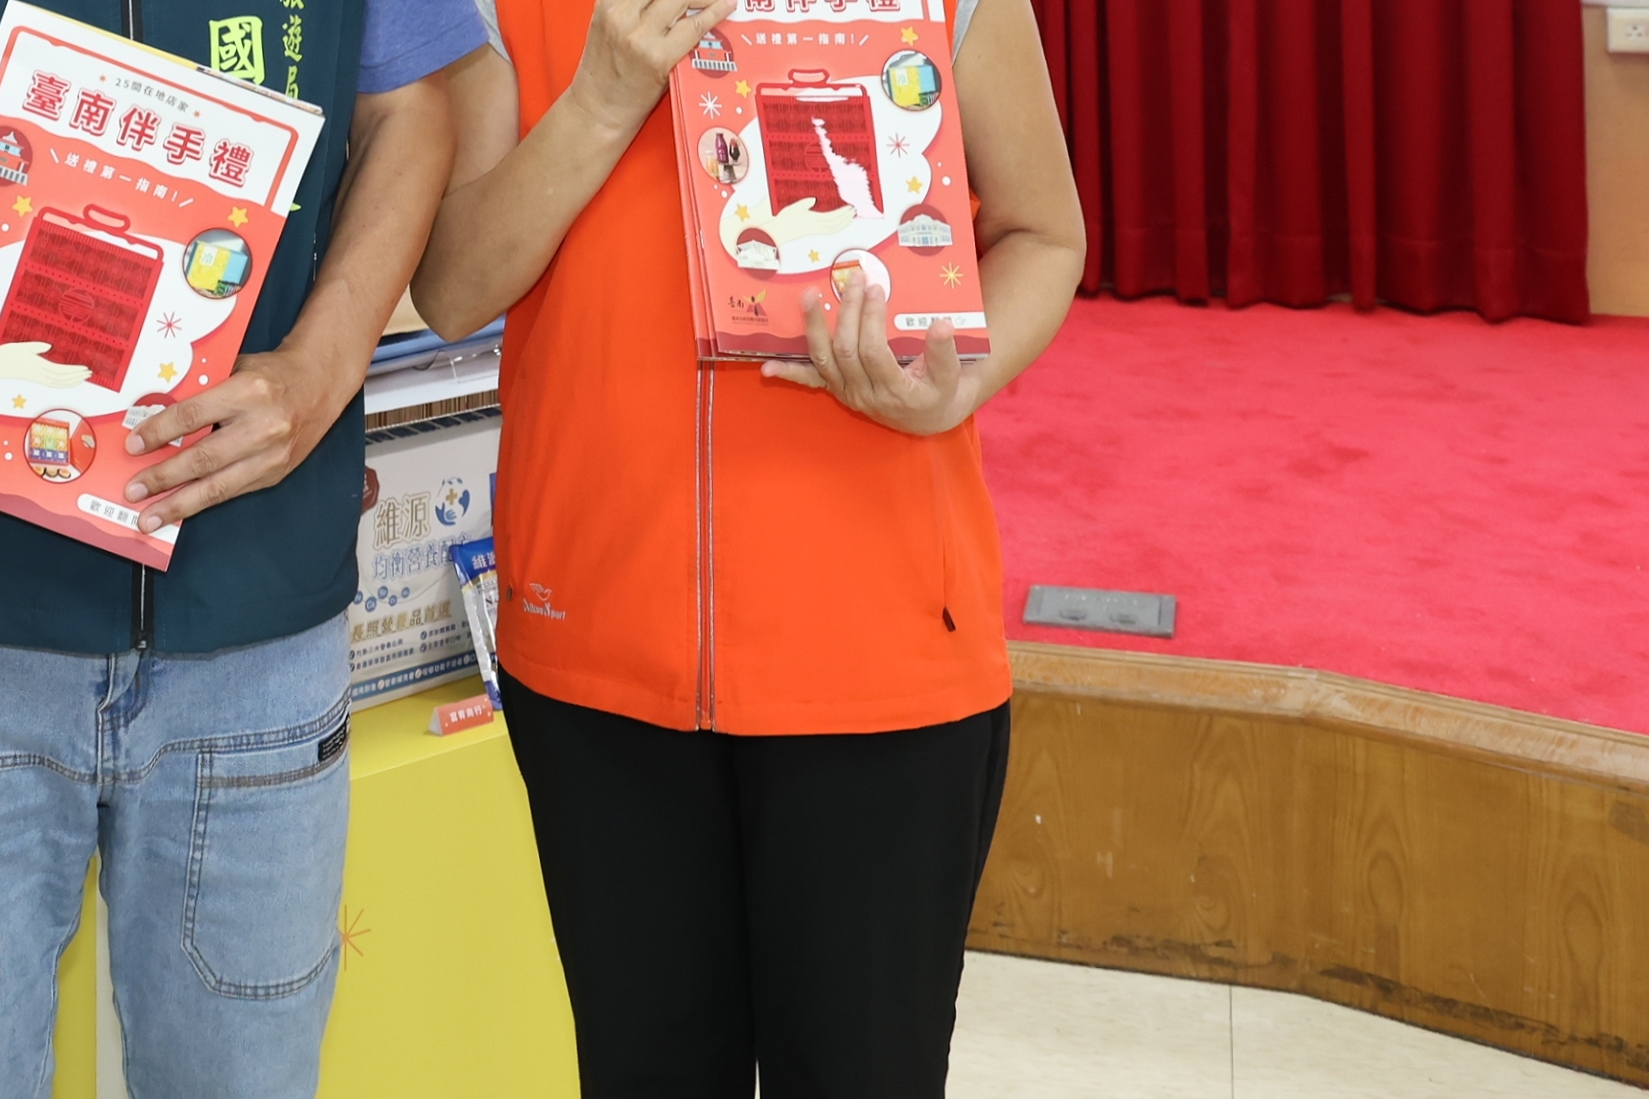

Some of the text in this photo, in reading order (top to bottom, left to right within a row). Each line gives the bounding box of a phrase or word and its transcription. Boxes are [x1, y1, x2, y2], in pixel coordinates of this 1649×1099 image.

[22, 69, 254, 187] 臺南伴手禮
[374, 492, 430, 549] 維源
[374, 533, 469, 581] 均衡營養配
